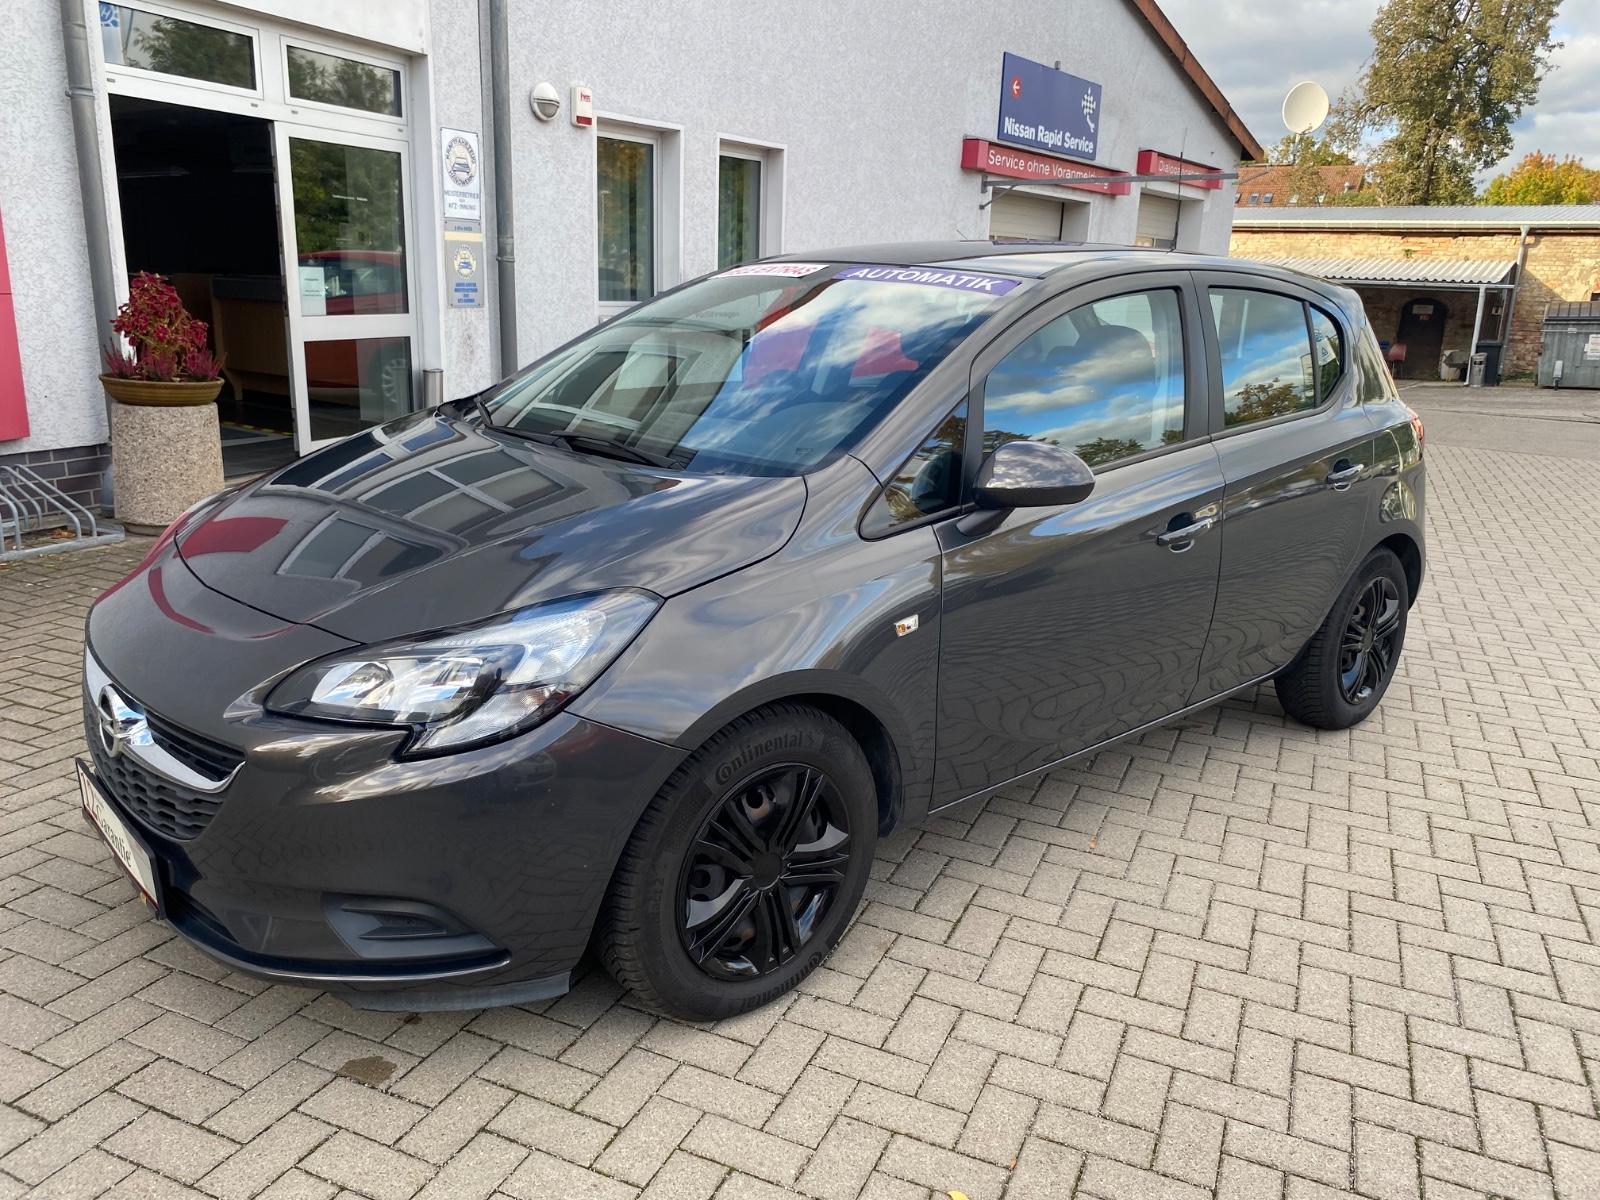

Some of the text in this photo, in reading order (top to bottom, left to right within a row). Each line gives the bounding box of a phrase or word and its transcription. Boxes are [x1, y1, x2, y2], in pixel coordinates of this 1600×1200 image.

[1004, 116, 1094, 153] Nissan Rapid Service
[988, 149, 1109, 190] Service ohne Voranmelg
[848, 267, 1003, 291] AUTOMATIK
[714, 730, 804, 786] Continental
